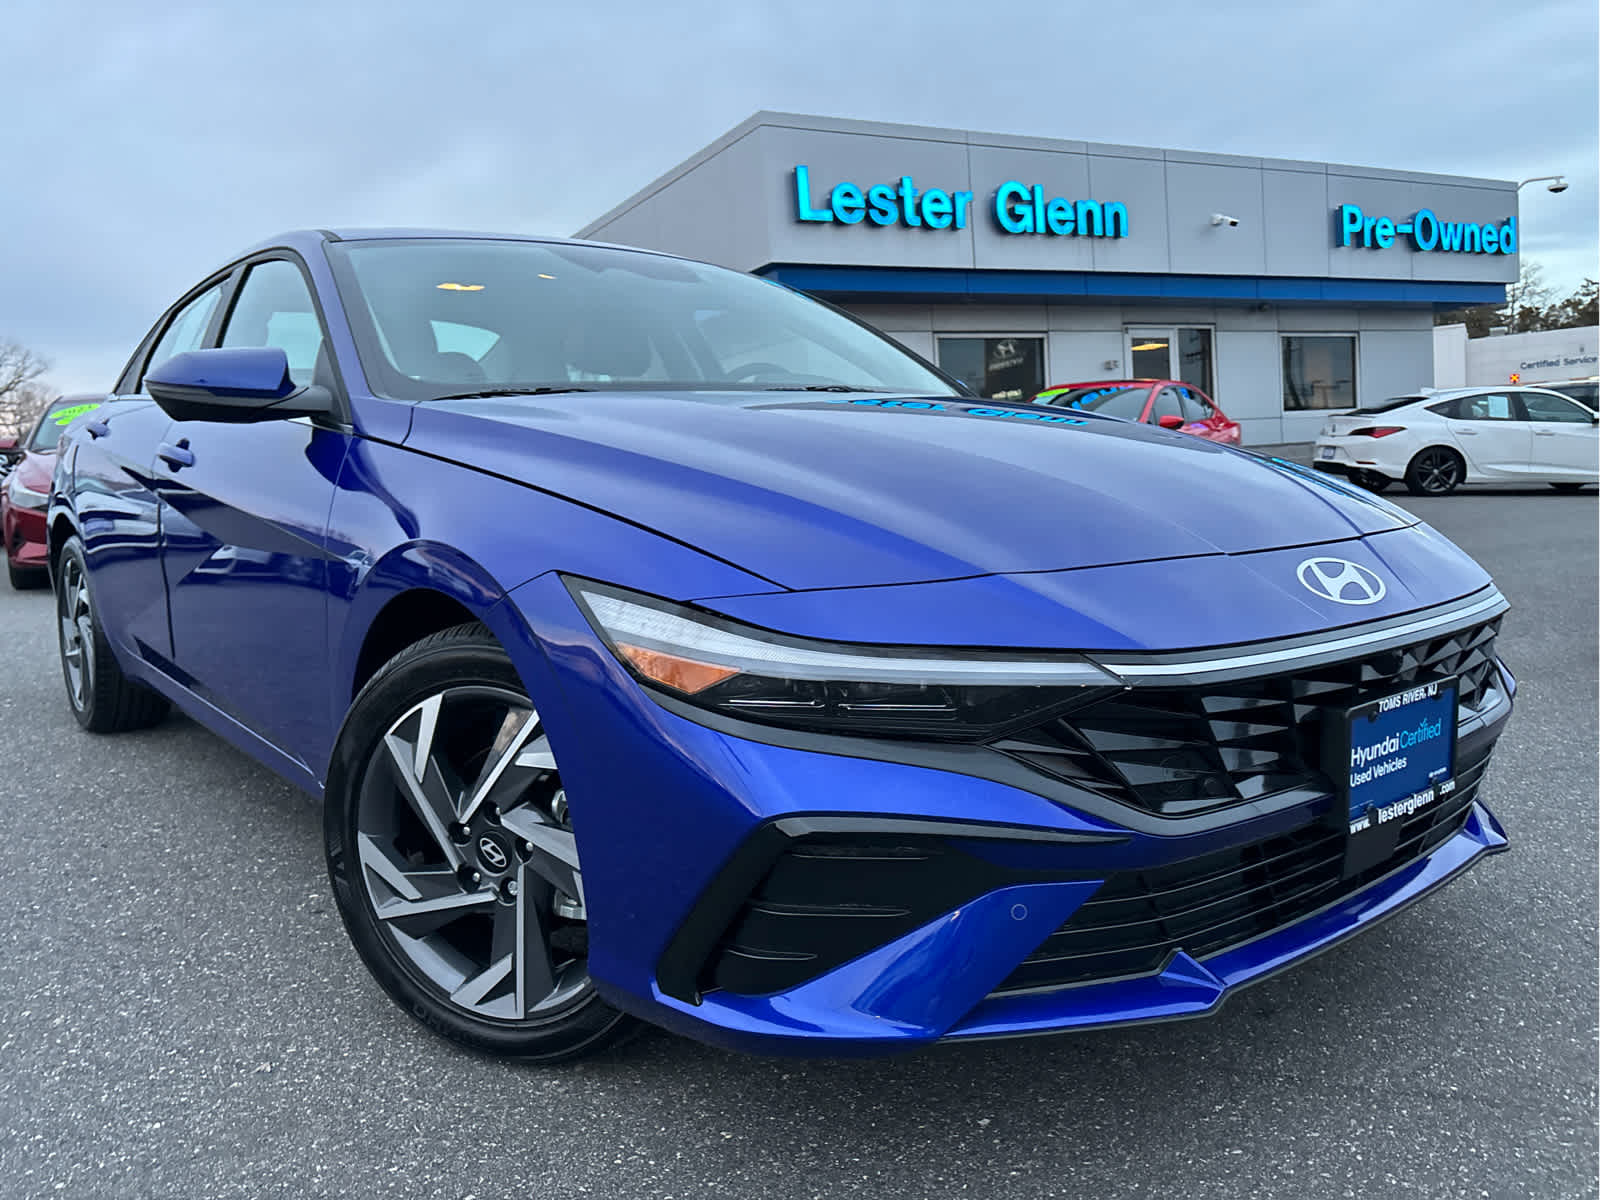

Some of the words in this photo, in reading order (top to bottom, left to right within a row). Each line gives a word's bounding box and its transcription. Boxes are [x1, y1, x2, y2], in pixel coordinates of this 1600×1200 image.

[794, 165, 973, 230] Lester
[995, 180, 1129, 239] Glenn
[1339, 203, 1518, 256] Pre-Owned
[1520, 357, 1560, 370] Certified
[1563, 355, 1598, 366] Service
[1378, 696, 1402, 713] TOMS
[1427, 683, 1438, 697] NJ
[1351, 733, 1400, 768] Hyundai
[1400, 718, 1442, 749] Certified
[1350, 769, 1372, 787] Used
[1372, 756, 1408, 779] Vehicles
[1349, 818, 1371, 834] www.
[1377, 789, 1434, 824] lesterglenn
[1439, 780, 1456, 795] .com
